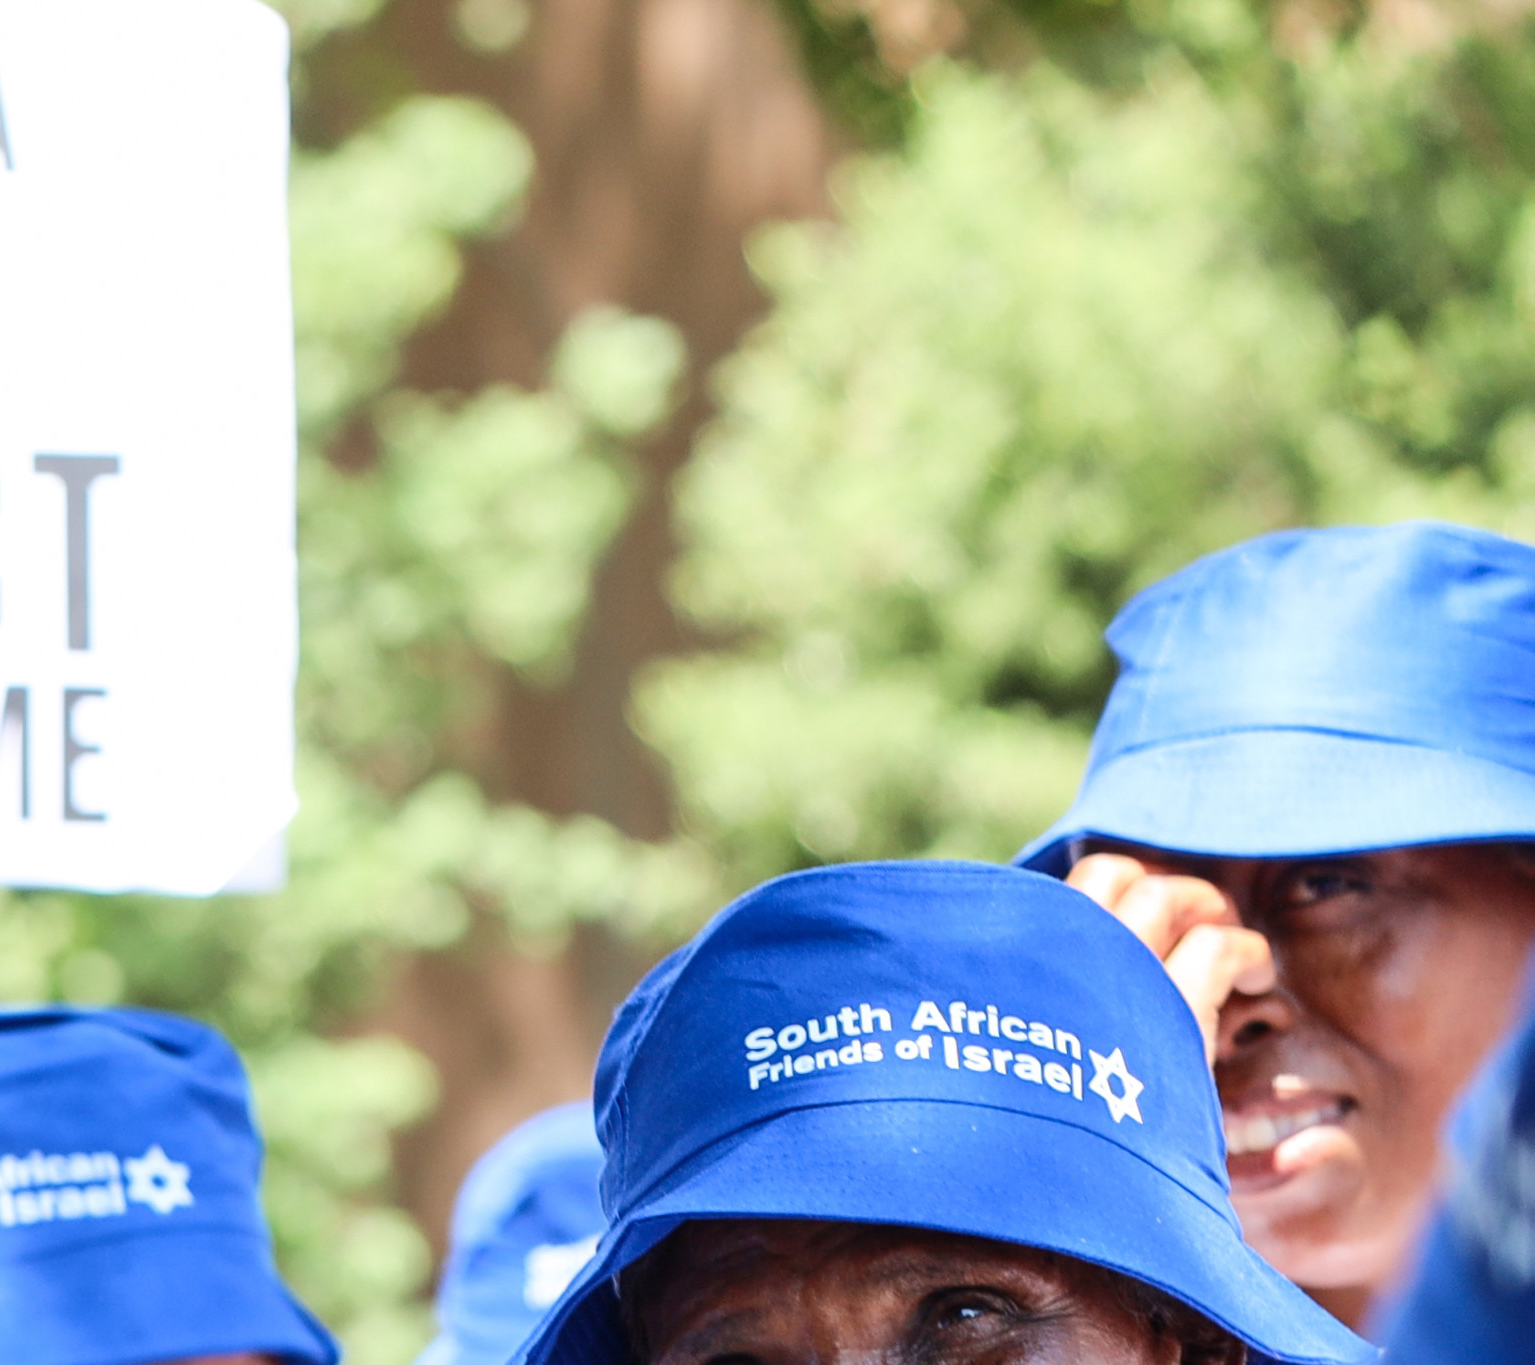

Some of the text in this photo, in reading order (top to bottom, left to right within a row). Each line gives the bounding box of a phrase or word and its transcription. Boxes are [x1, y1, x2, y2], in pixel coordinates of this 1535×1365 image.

[745, 1001, 1082, 1062] South African
[748, 1035, 1084, 1101] Friends of Israel
